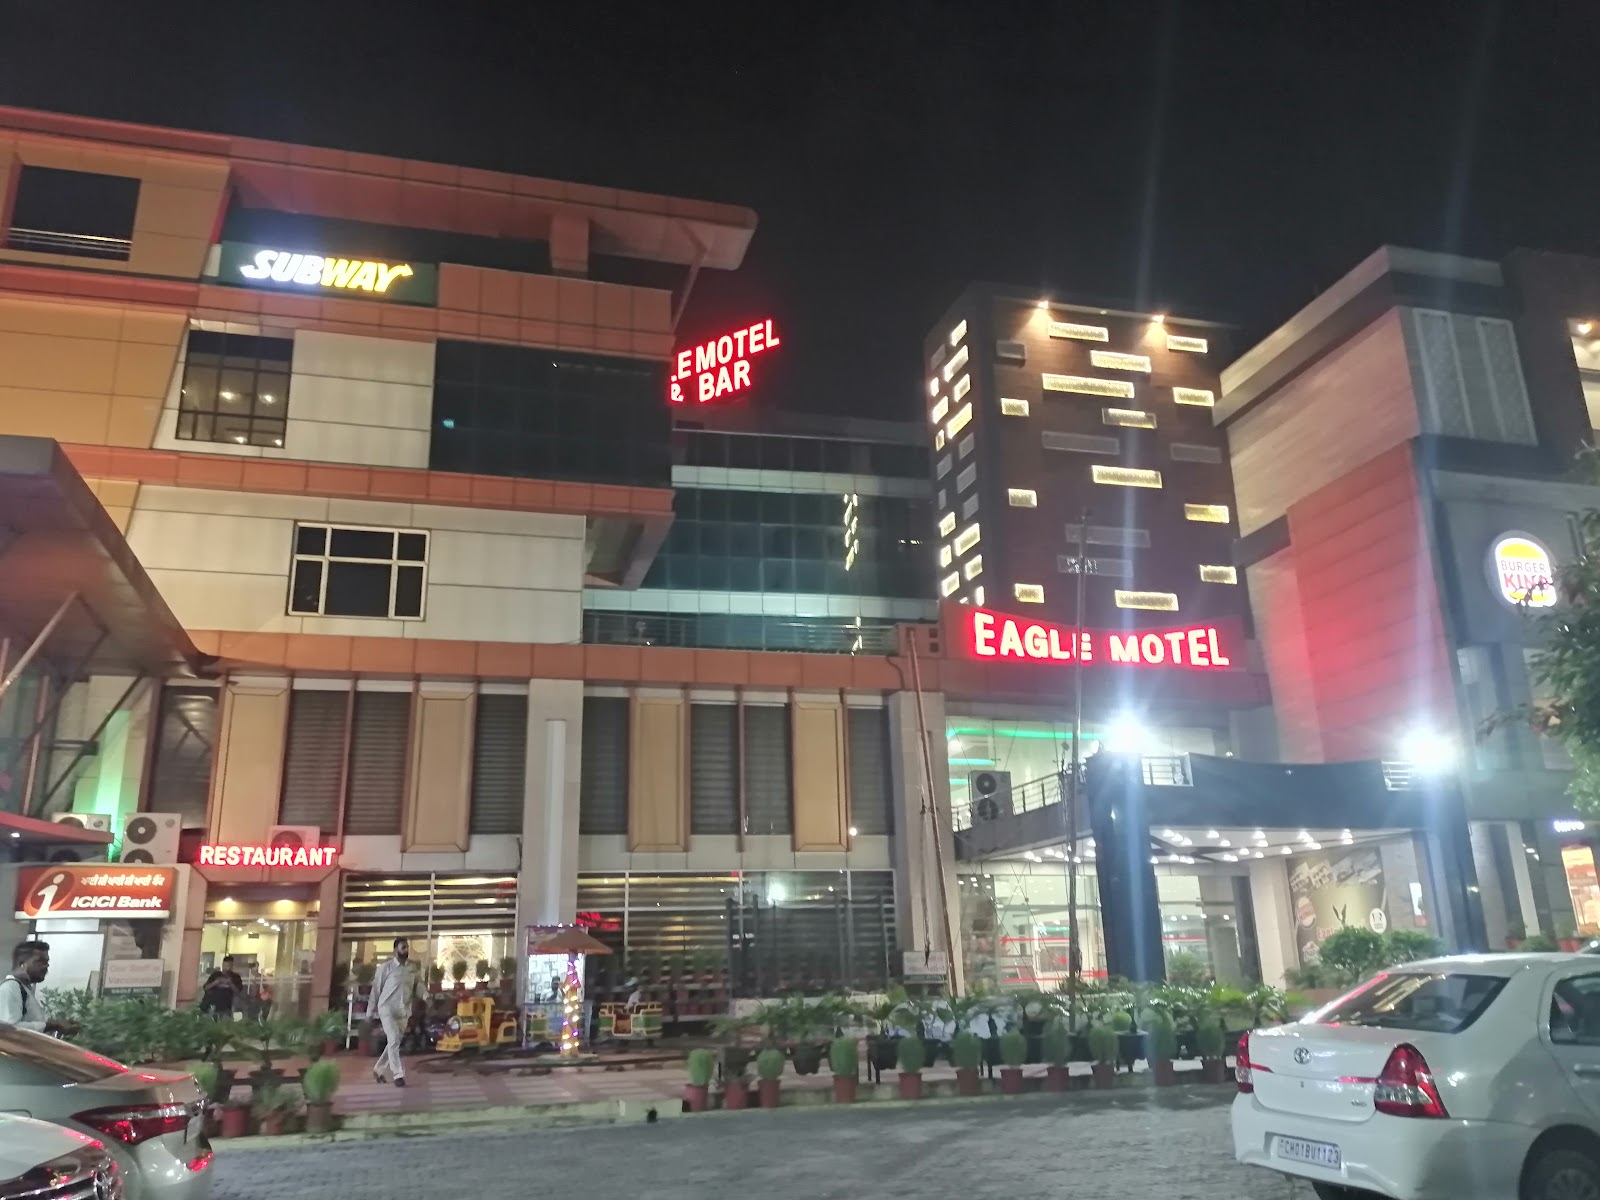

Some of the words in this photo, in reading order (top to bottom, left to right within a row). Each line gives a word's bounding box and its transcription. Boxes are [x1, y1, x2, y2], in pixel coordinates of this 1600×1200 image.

[240, 250, 414, 292] SUBWAY
[696, 319, 780, 373] MOTEL
[699, 360, 751, 402] BAR
[1501, 560, 1546, 573] BURGER
[974, 612, 1092, 661] EAGLE
[1110, 628, 1230, 666] MOTEL
[200, 845, 336, 866] RESTAURANT
[71, 896, 116, 908] ICICI
[117, 895, 162, 908] Bank
[1285, 1141, 1339, 1164] CH01BU1123
